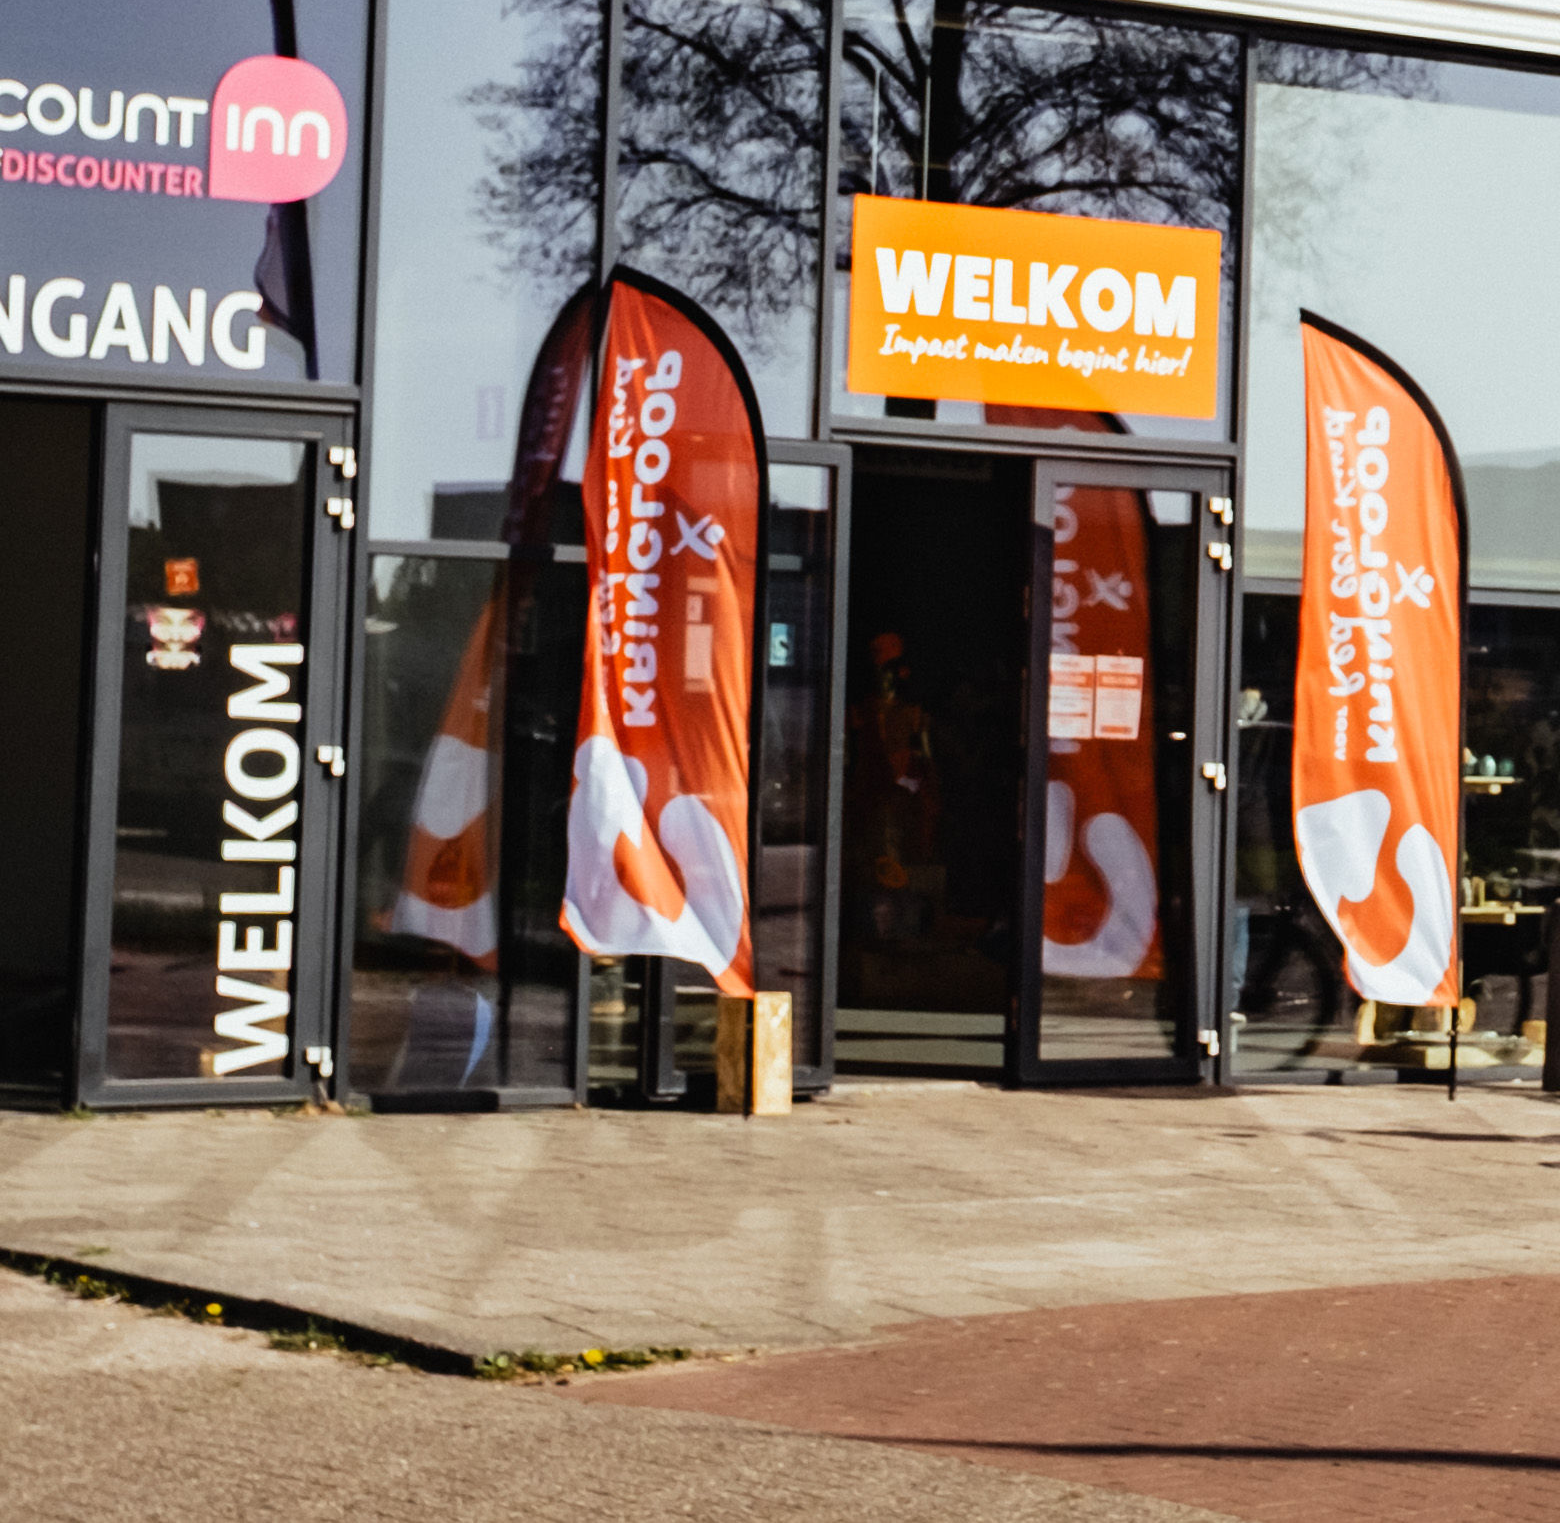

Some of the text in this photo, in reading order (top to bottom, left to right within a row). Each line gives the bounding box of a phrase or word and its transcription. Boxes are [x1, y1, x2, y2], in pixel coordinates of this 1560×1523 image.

[875, 246, 1197, 340] WELKOM
[878, 323, 1193, 378] Impact maken begint hier!
[213, 645, 304, 1075] WELKOM
